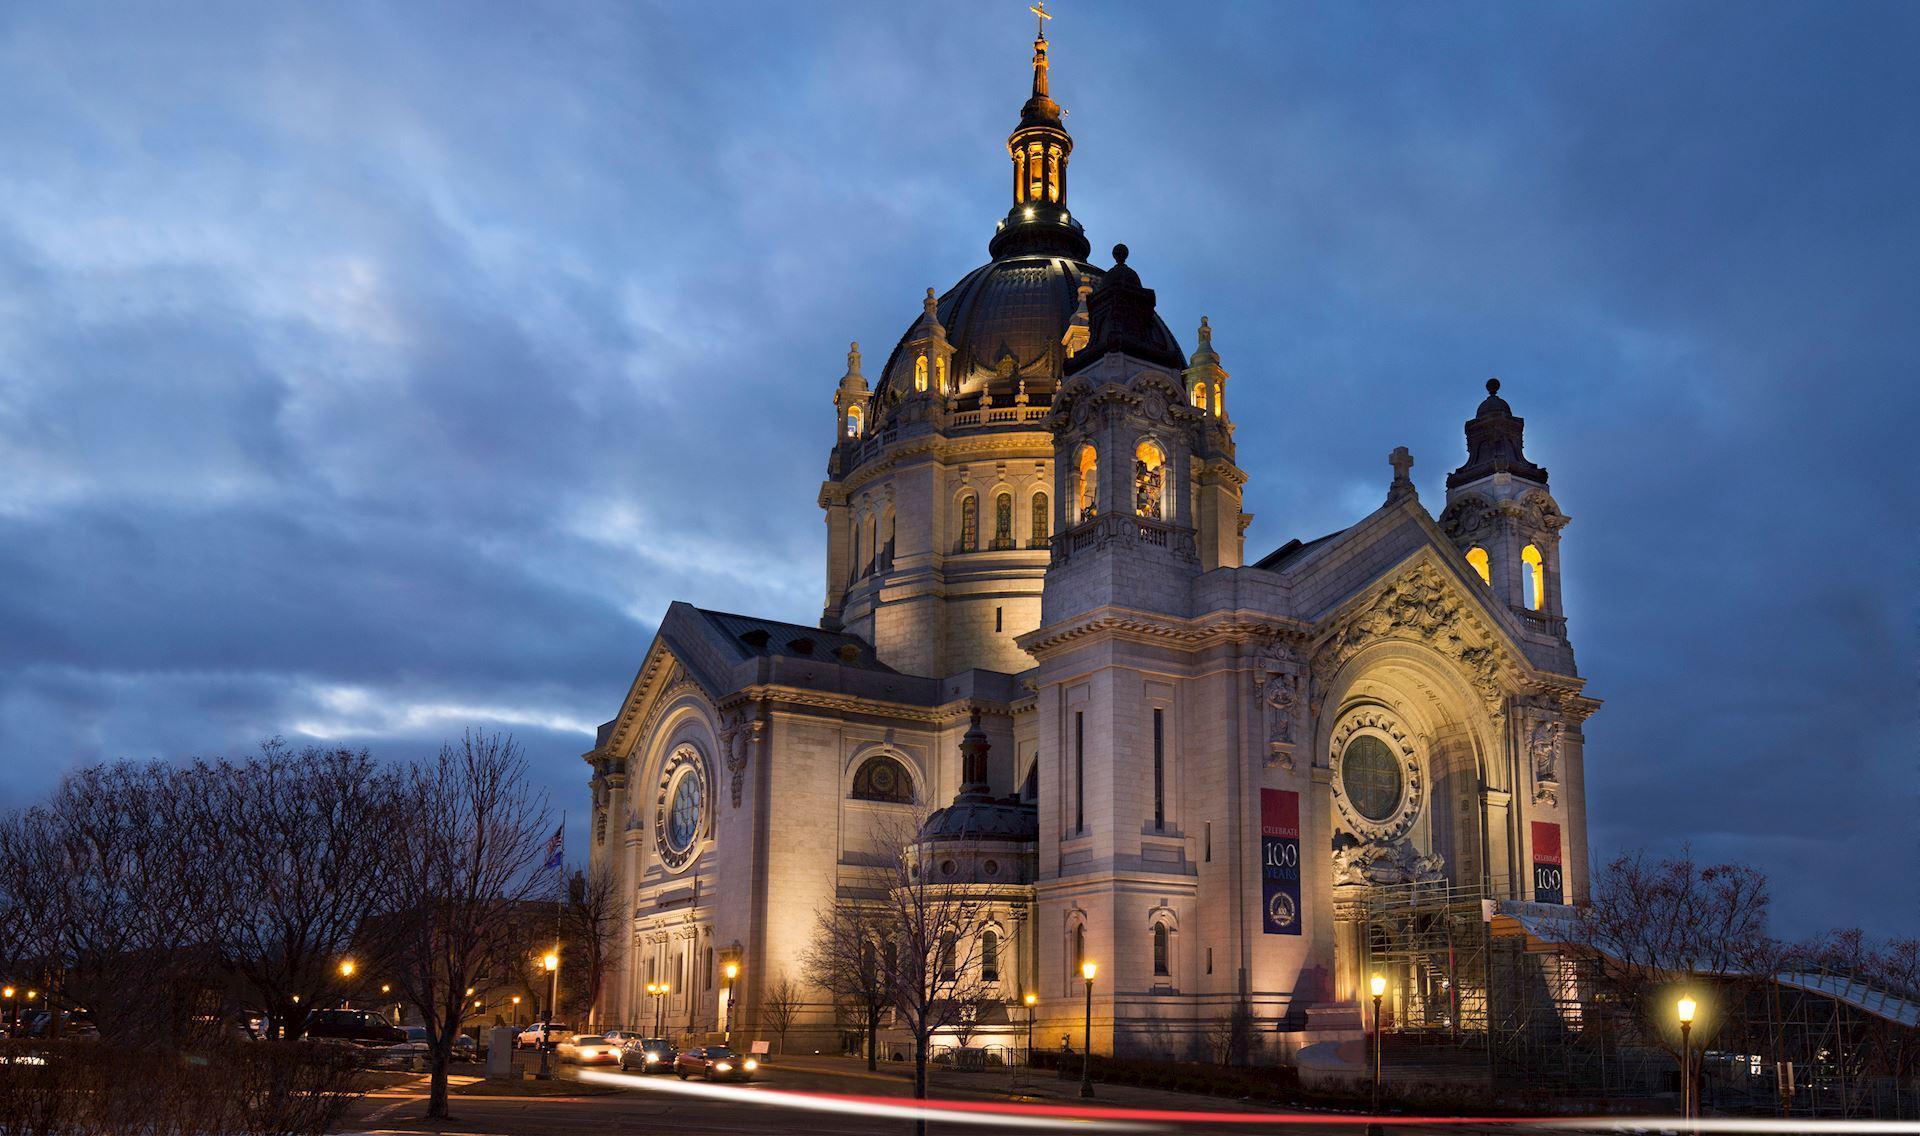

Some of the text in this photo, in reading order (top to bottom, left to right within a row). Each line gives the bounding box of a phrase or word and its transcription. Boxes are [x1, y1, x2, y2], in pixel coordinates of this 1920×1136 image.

[1263, 825, 1298, 836] CELEBRATE
[1265, 842, 1297, 867] 100
[1266, 868, 1297, 880] YEARS
[1536, 868, 1561, 890] 100
